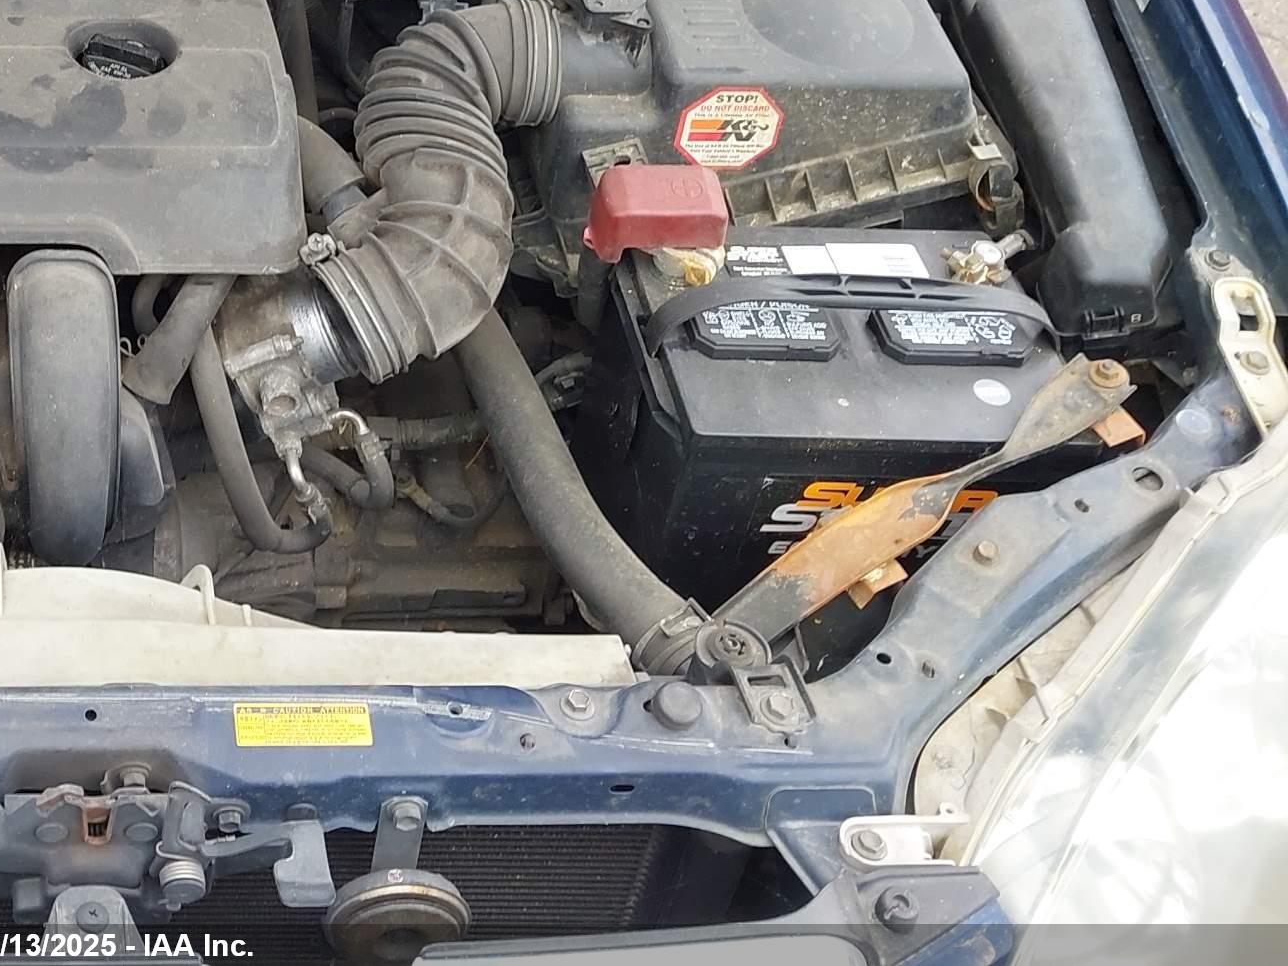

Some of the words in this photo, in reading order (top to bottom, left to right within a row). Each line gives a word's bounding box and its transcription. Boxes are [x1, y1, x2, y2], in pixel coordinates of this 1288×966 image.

[716, 94, 759, 104] STOP!
[733, 105, 771, 113] DISCARD
[796, 481, 998, 514] SUR
[273, 706, 314, 715] CAUTION
[319, 706, 367, 715] ATTENTION
